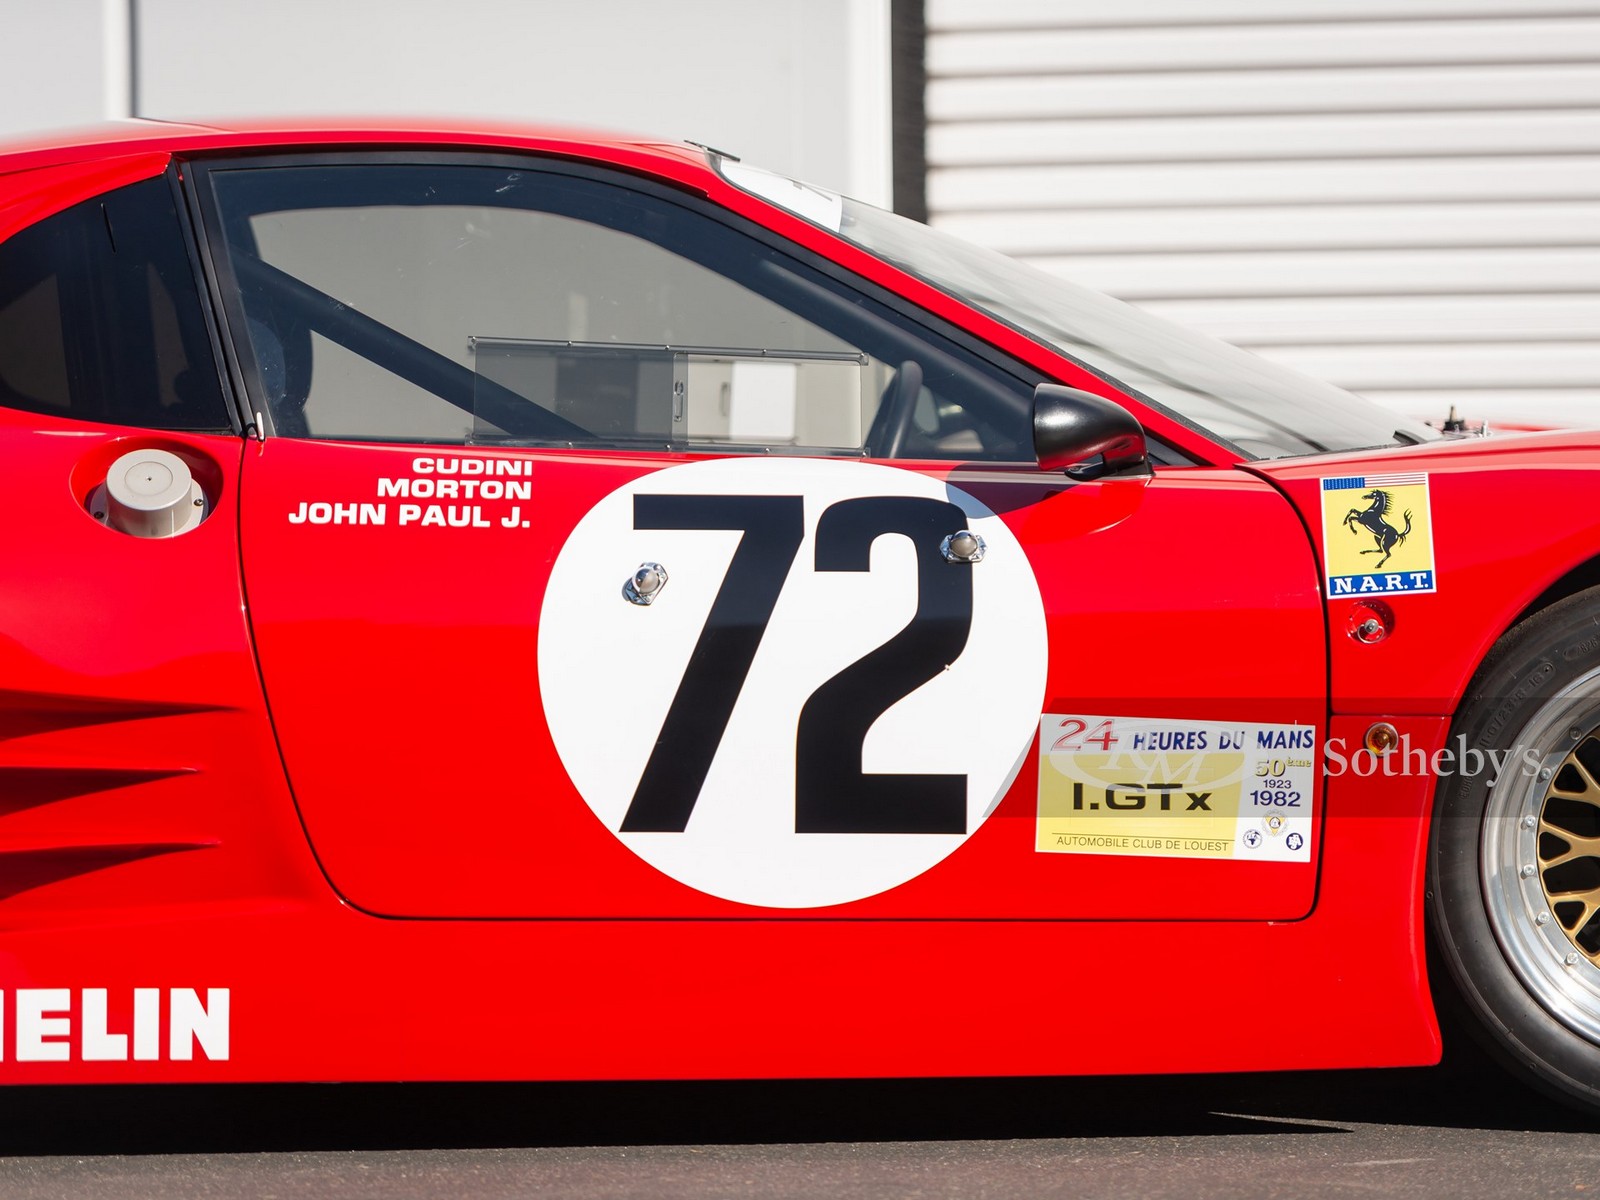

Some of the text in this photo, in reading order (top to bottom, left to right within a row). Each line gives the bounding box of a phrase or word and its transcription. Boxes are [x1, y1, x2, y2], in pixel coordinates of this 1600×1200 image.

[412, 457, 533, 477] CUDINI
[377, 477, 532, 500] MORTON
[288, 502, 531, 528] JOHN PAUL J.
[1334, 571, 1430, 594] N.A.R.T.
[619, 493, 973, 835] 72
[1050, 716, 1314, 751] 24 HEURES DU MANS
[1263, 779, 1292, 789] 1923
[1249, 790, 1301, 807] 1982
[1056, 835, 1130, 849] AUTOMOBILE
[1132, 838, 1162, 850] CLUB
[1165, 839, 1181, 850] DE
